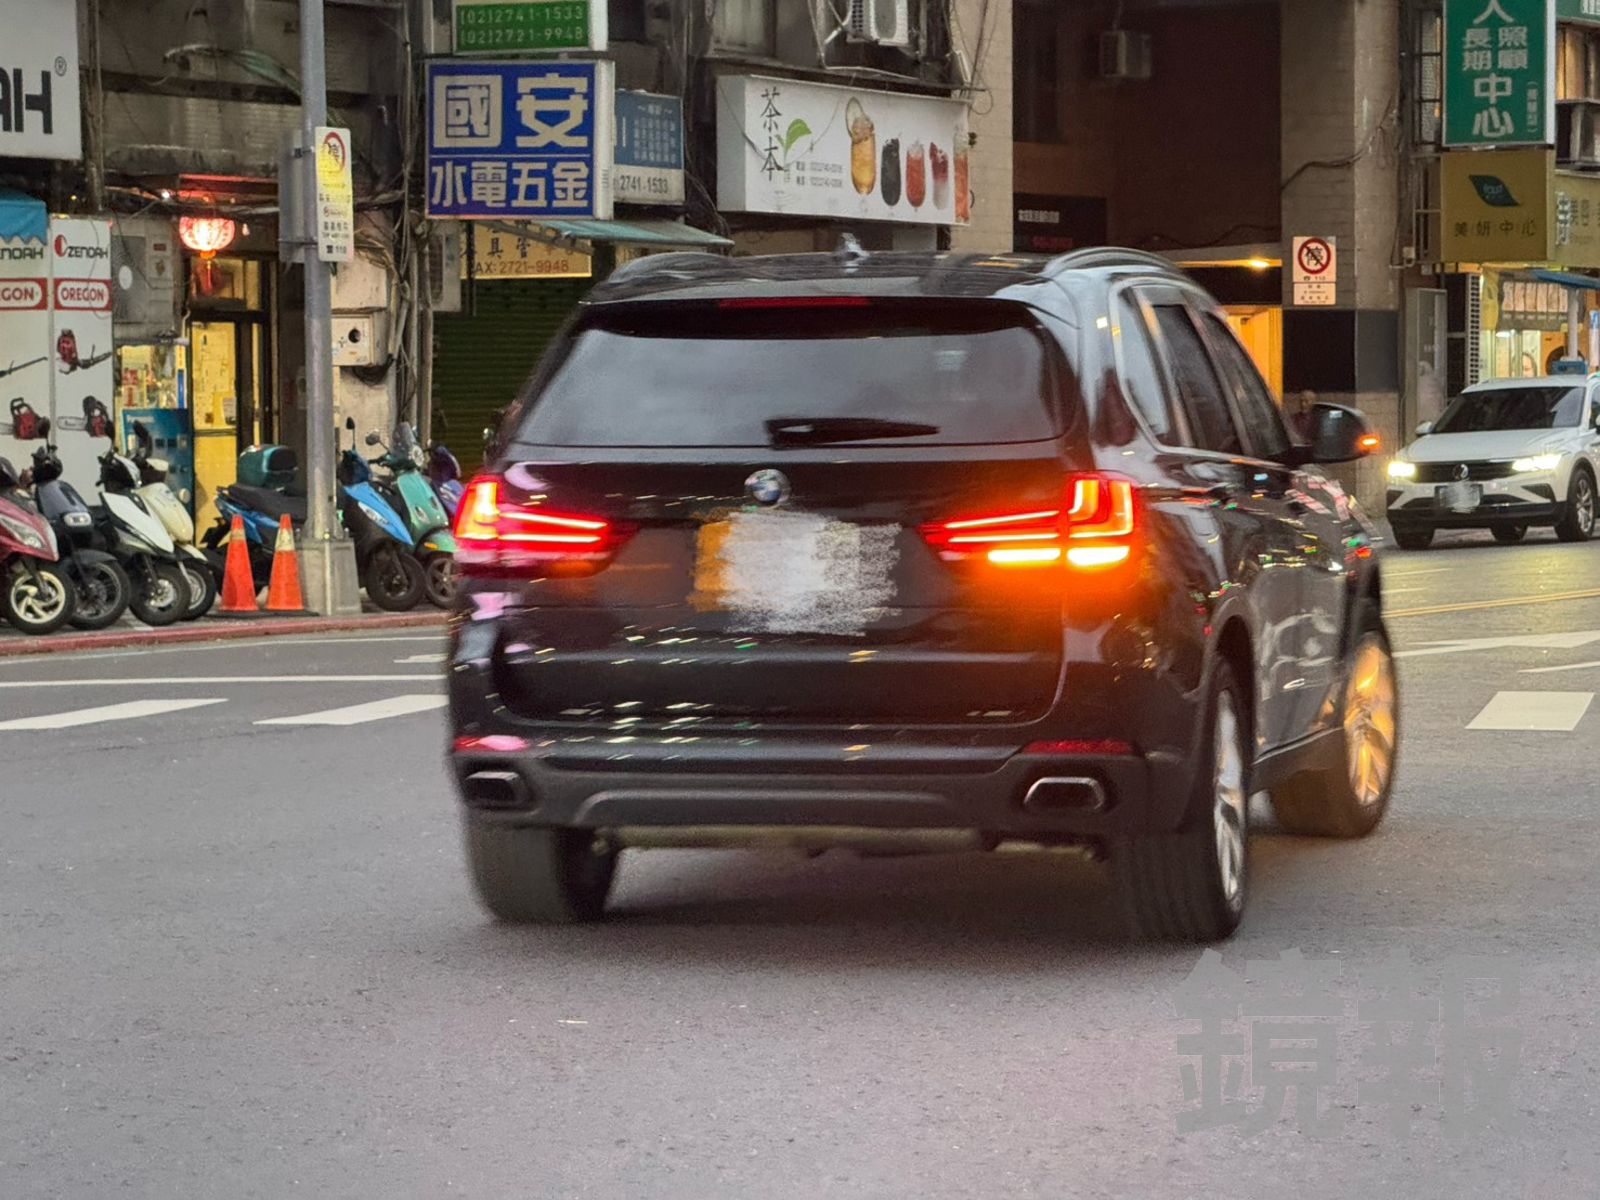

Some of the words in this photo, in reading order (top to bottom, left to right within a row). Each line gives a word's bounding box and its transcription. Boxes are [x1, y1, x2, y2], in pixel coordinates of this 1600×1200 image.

[433, 73, 588, 147] 國安
[1473, 73, 1514, 137] 中心
[432, 161, 588, 207] 水電五金
[67, 245, 109, 259] ZENOAH
[475, 260, 569, 274] AX:2721-9948
[1, 288, 34, 301] GON
[61, 287, 105, 301] OREGON
